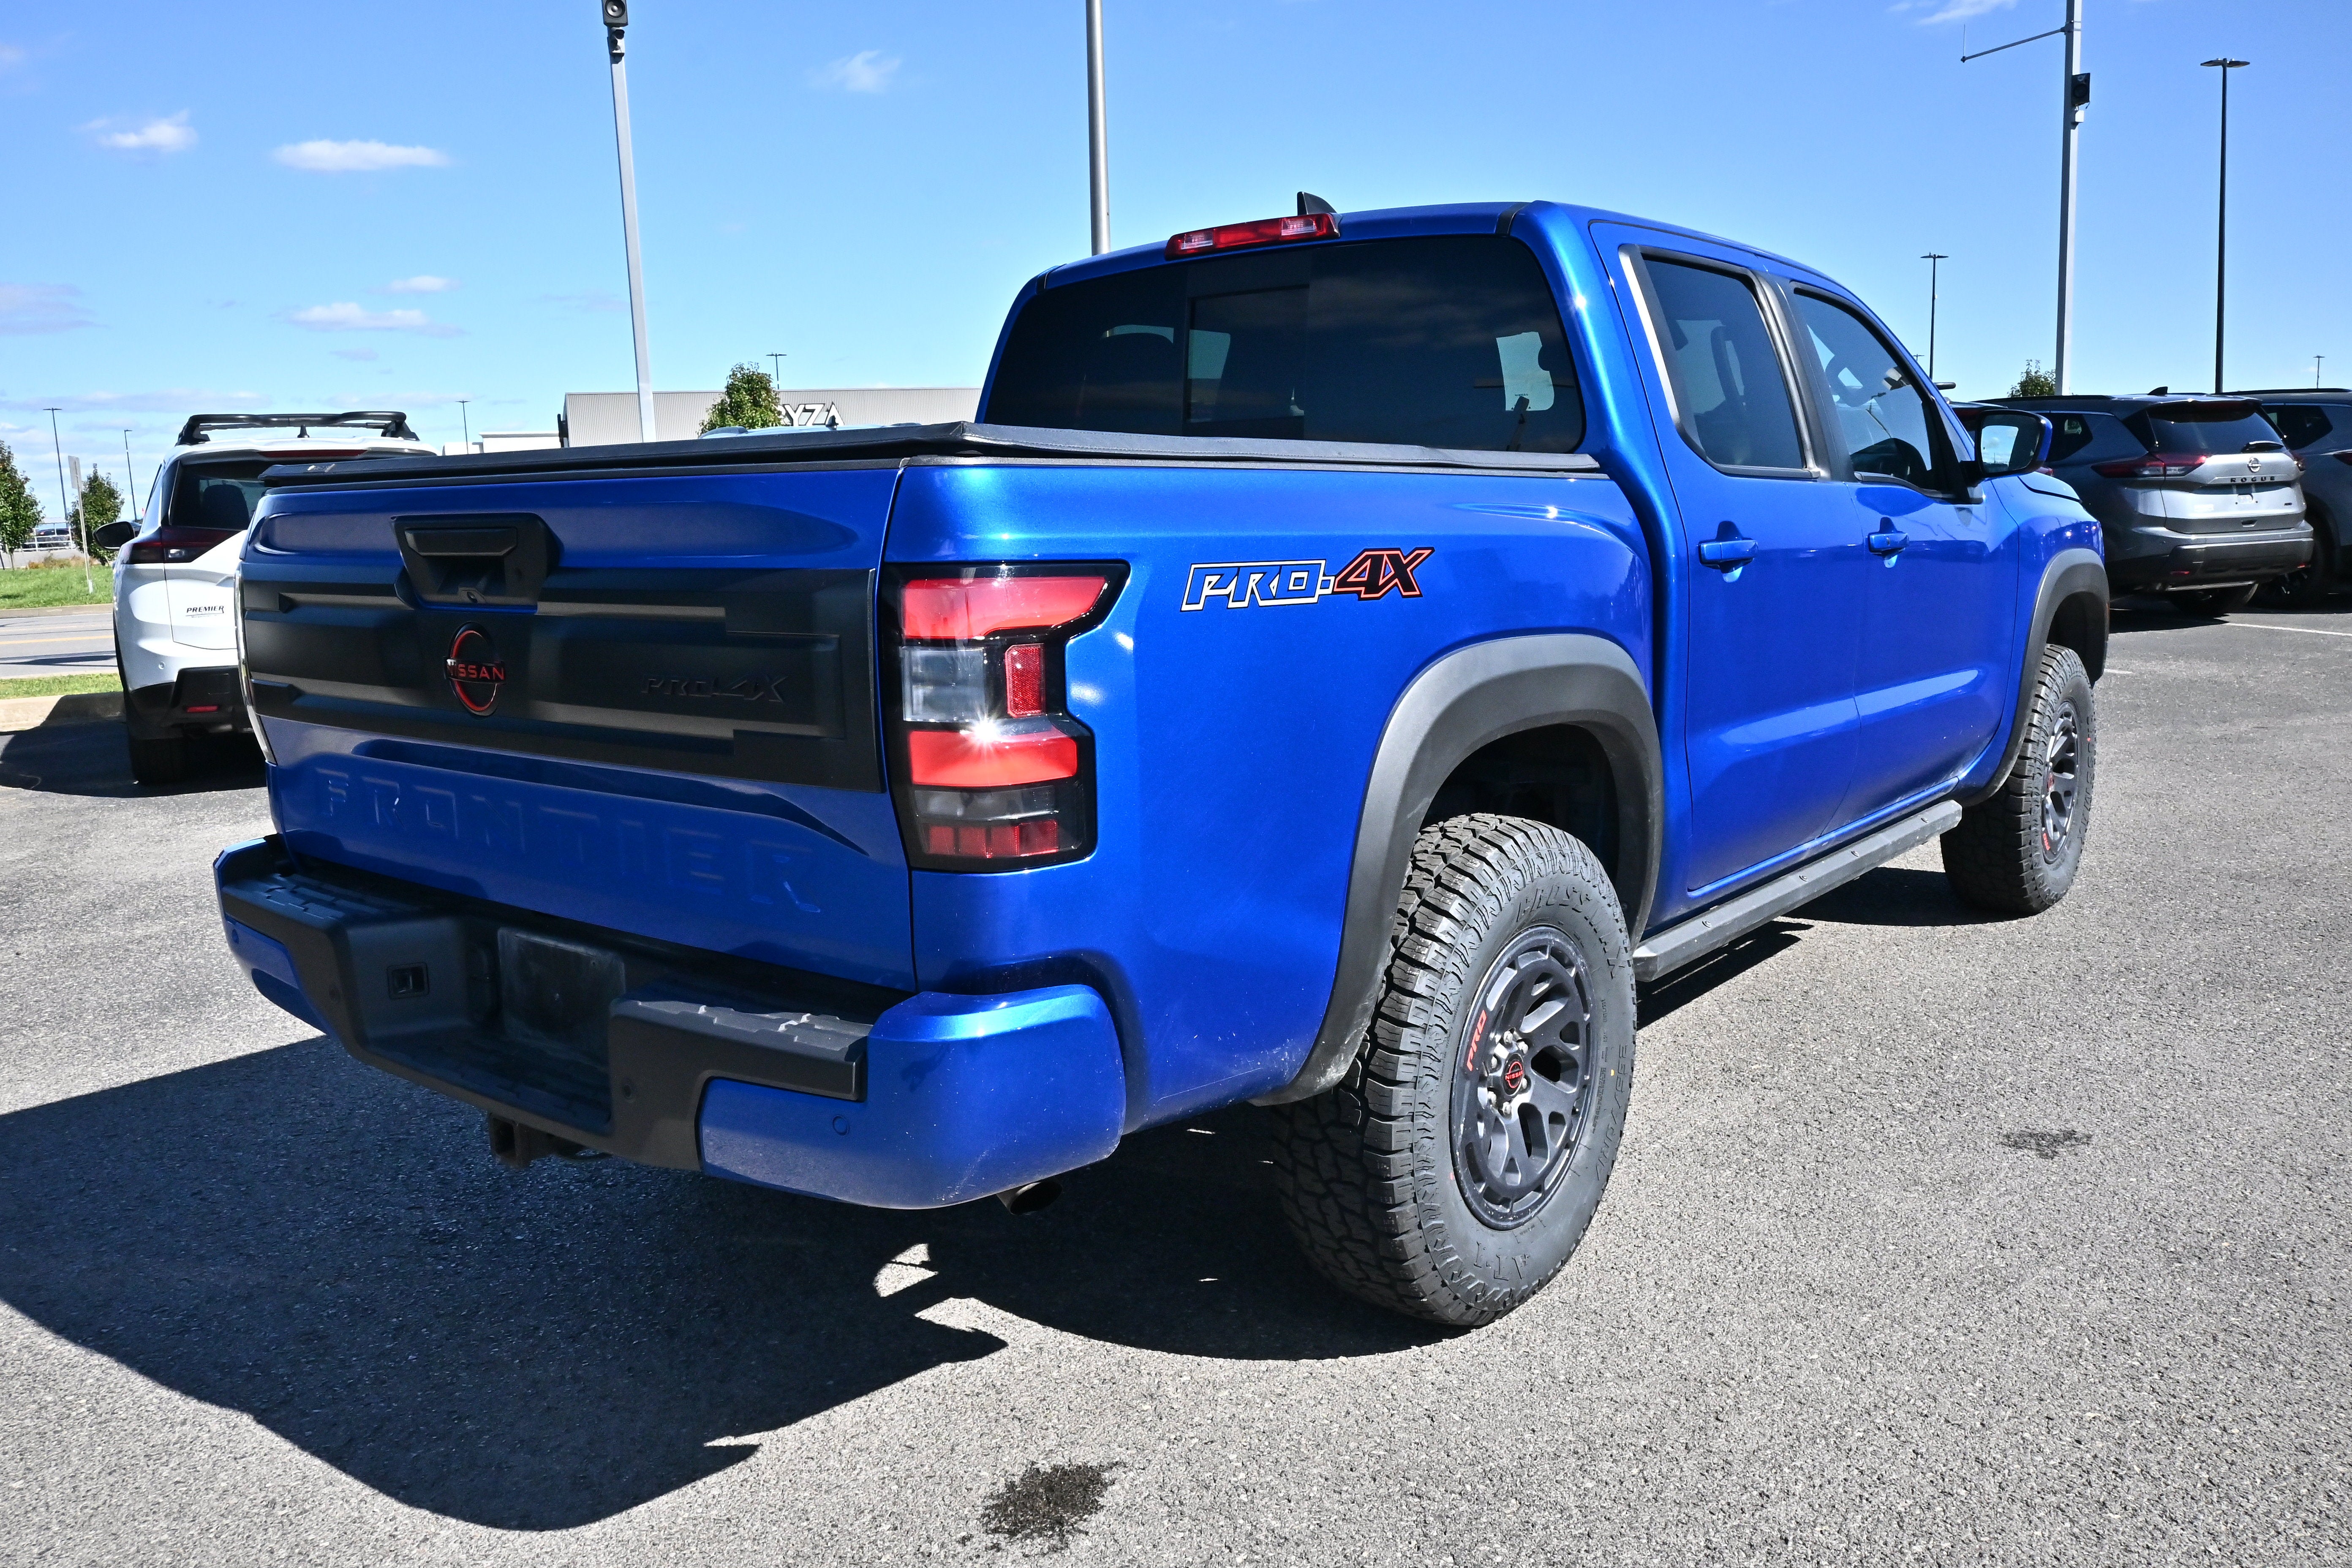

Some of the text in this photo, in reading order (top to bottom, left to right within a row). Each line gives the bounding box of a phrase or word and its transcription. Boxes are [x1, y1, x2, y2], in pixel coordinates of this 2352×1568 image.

[186, 605, 224, 613] PREMIER
[1180, 547, 1435, 612] PRO-4X
[447, 659, 505, 680] NISSAN
[314, 766, 822, 914] FRONTIER
[1467, 1010, 1487, 1071] PRO
